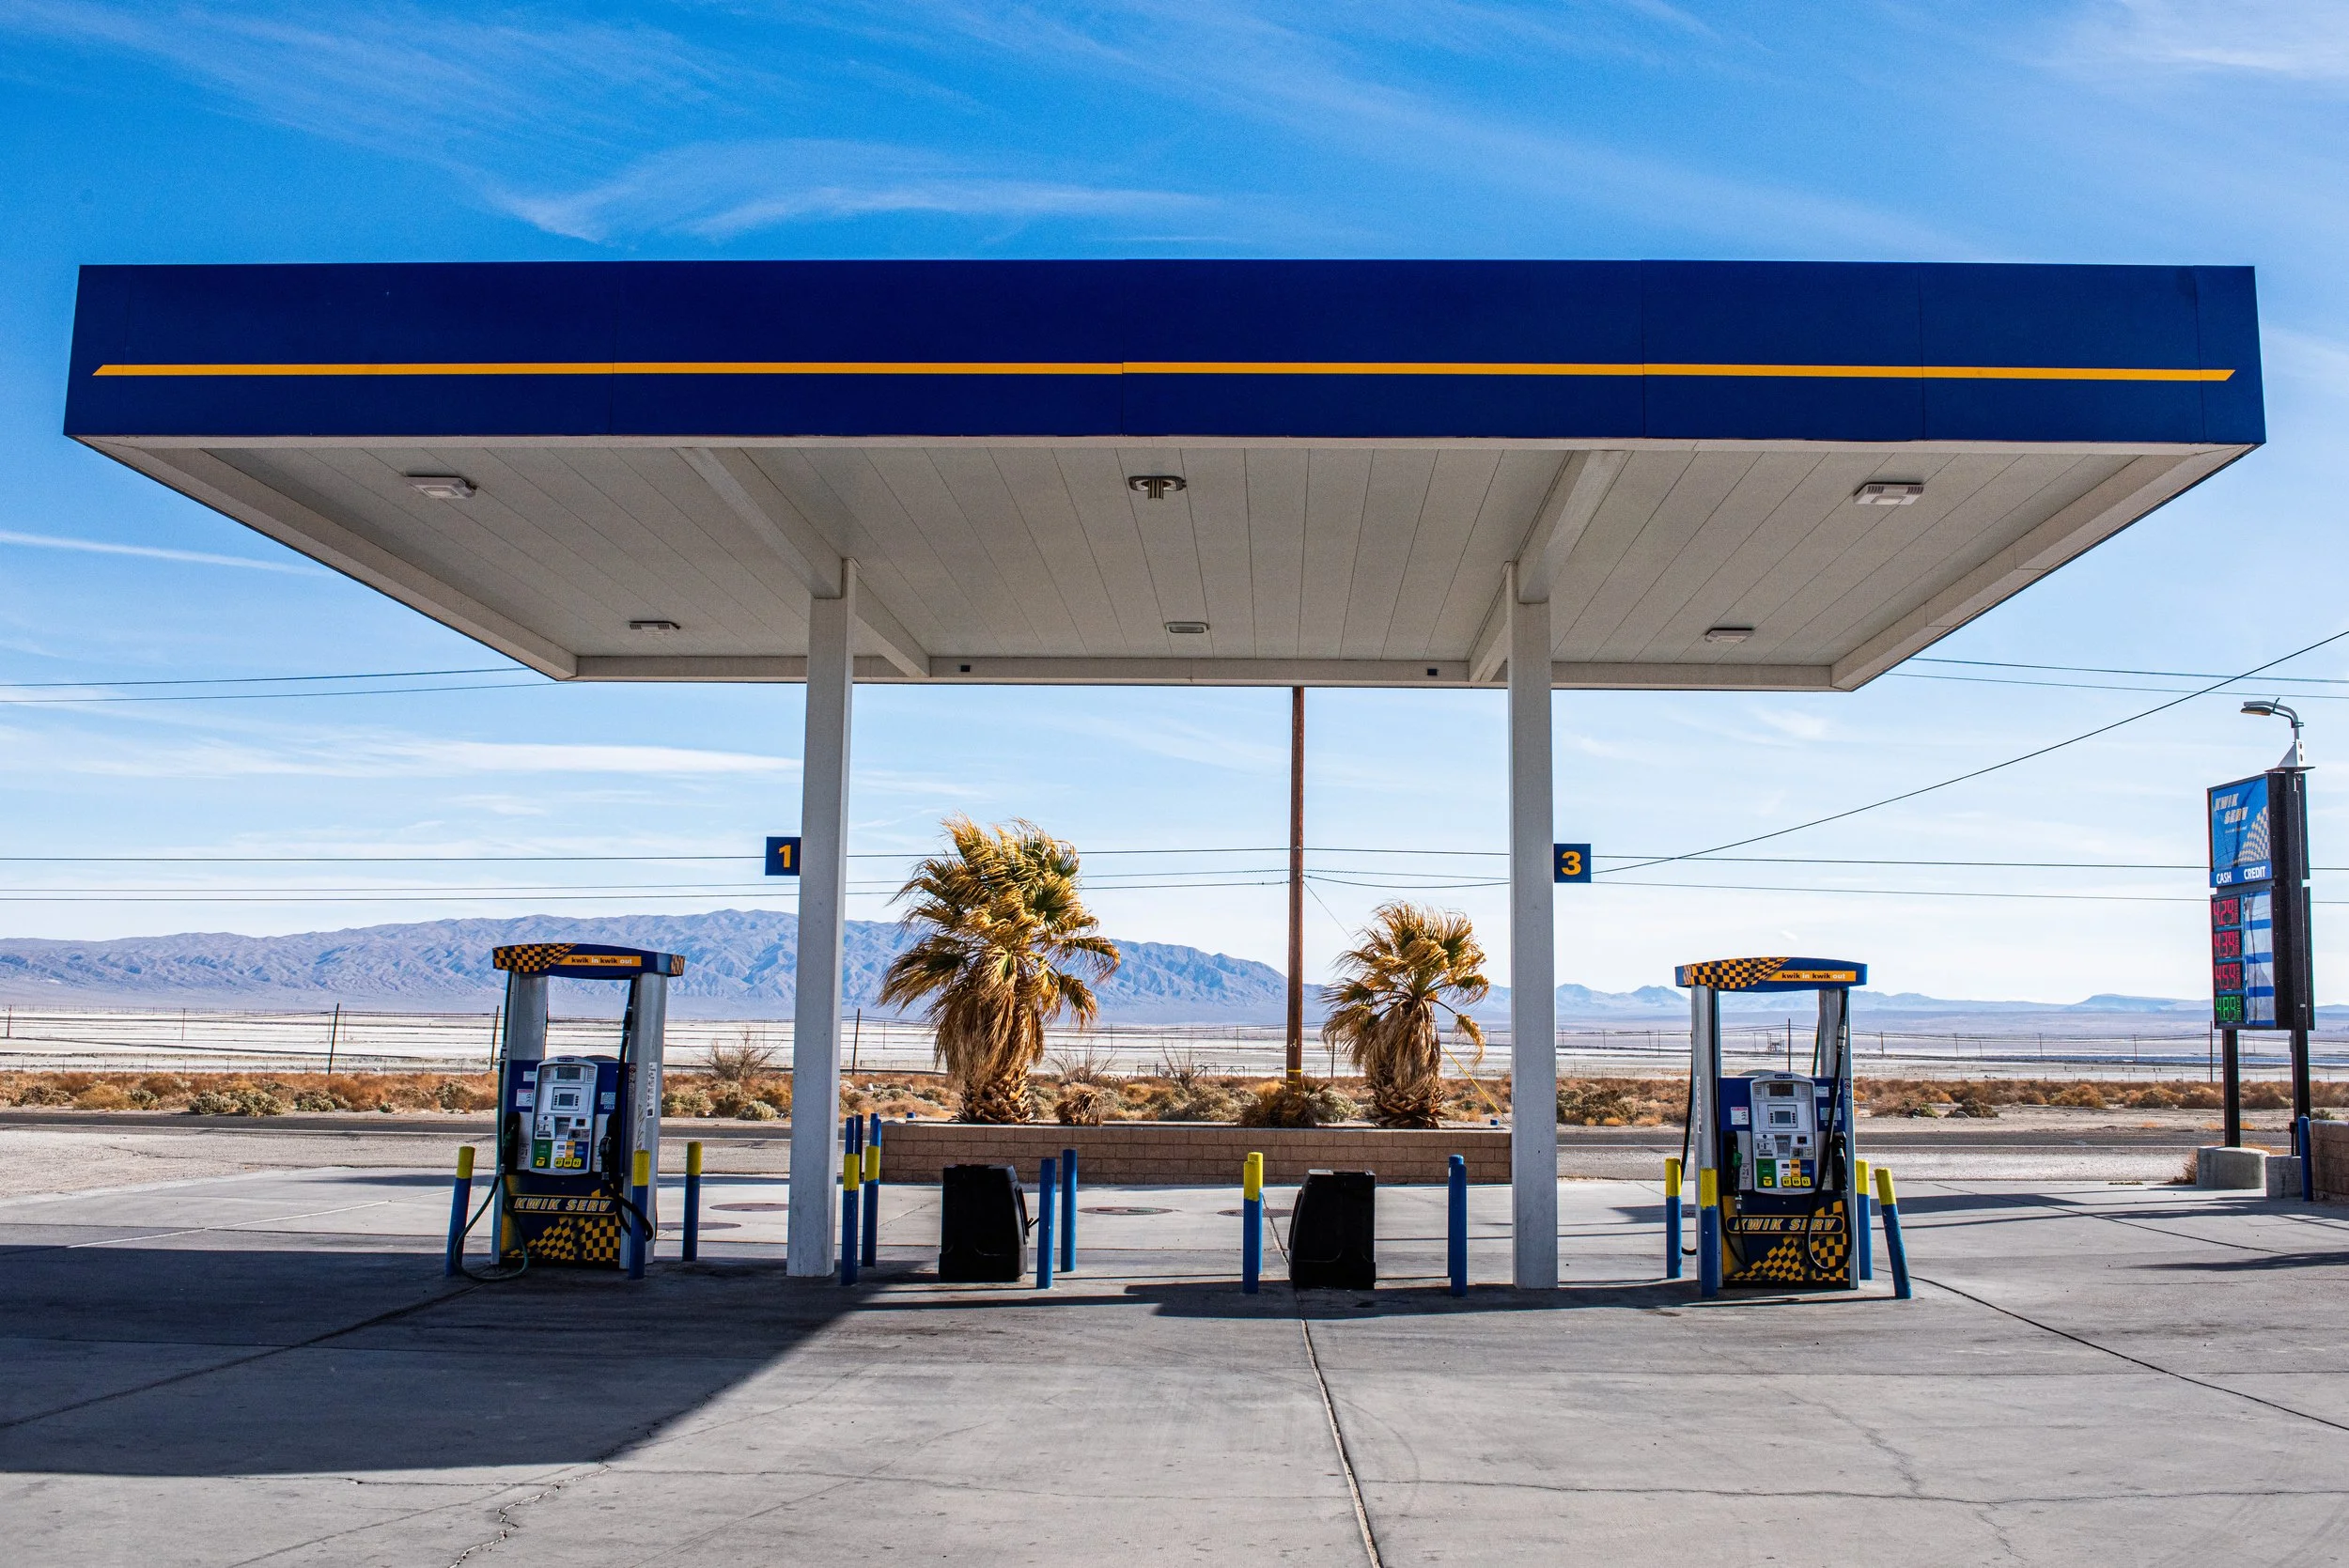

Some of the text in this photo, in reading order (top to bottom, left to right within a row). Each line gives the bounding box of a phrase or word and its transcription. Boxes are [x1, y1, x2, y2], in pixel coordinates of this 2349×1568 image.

[2215, 793, 2239, 812] KWIK
[2224, 806, 2248, 824] SERV
[778, 844, 792, 868] 1
[1561, 850, 1582, 876] 3
[2216, 865, 2266, 884] CASH CREDIT
[514, 1197, 612, 1212] KWIK SERV
